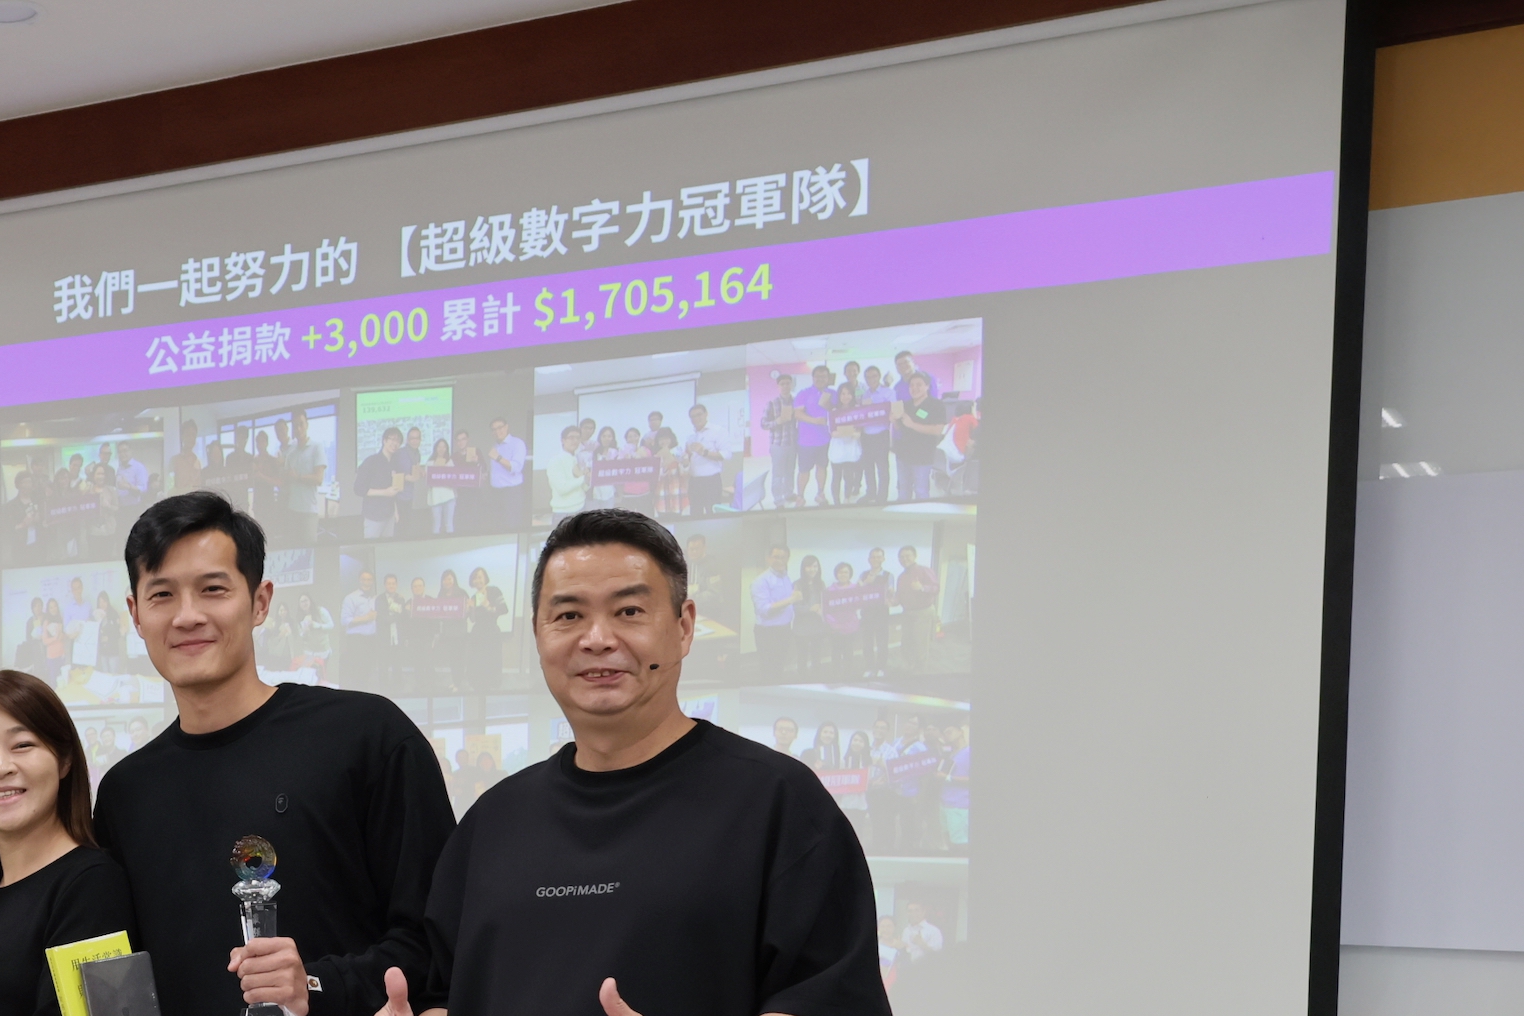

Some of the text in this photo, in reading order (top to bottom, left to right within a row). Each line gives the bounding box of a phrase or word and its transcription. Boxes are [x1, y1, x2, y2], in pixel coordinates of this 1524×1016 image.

[53, 158, 870, 324] 我們一起努力的 【超級數字力冠軍隊】
[145, 262, 774, 376] 公益捐款 +3,000 累計 $1,705,164
